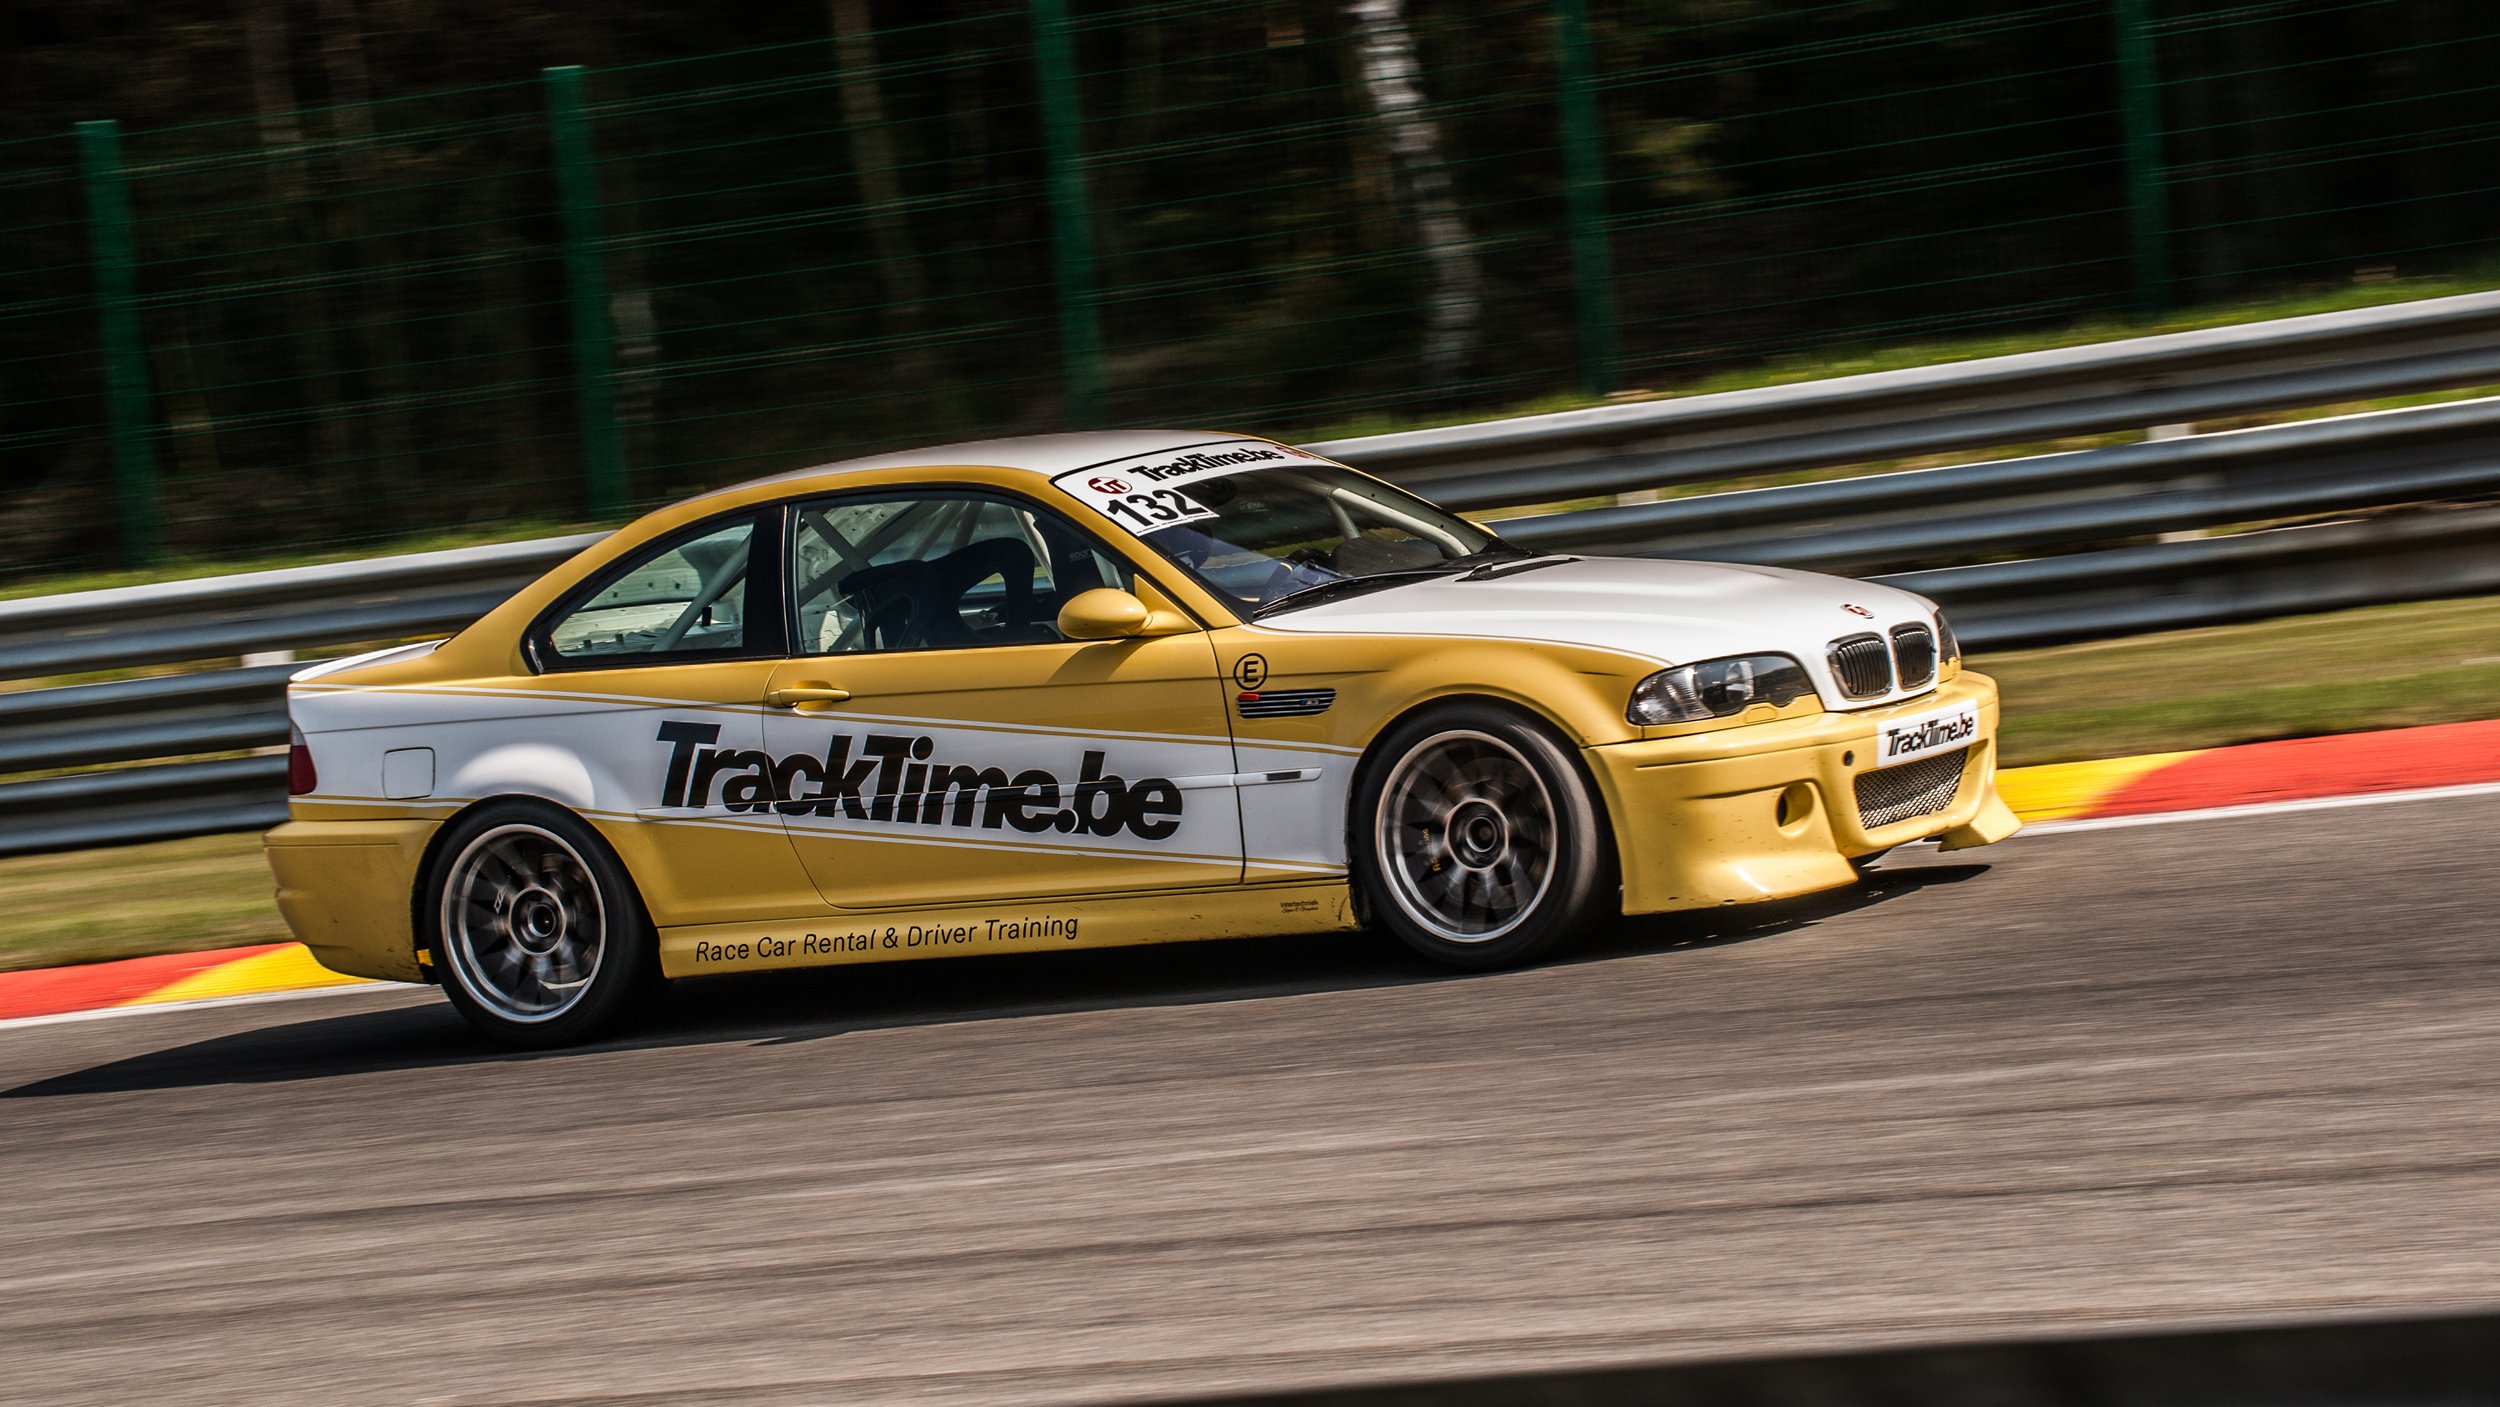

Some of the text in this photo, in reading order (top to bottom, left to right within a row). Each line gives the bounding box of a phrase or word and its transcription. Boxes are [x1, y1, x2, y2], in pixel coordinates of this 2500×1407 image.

[1127, 448, 1285, 482] TrackTime.be
[1107, 489, 1208, 527] 132
[1243, 660, 1259, 683] E
[1887, 712, 1974, 757] TrackTime.be
[656, 720, 1184, 841] TrackTime.be
[696, 915, 1079, 962] Race Car Rental & Driver Training
